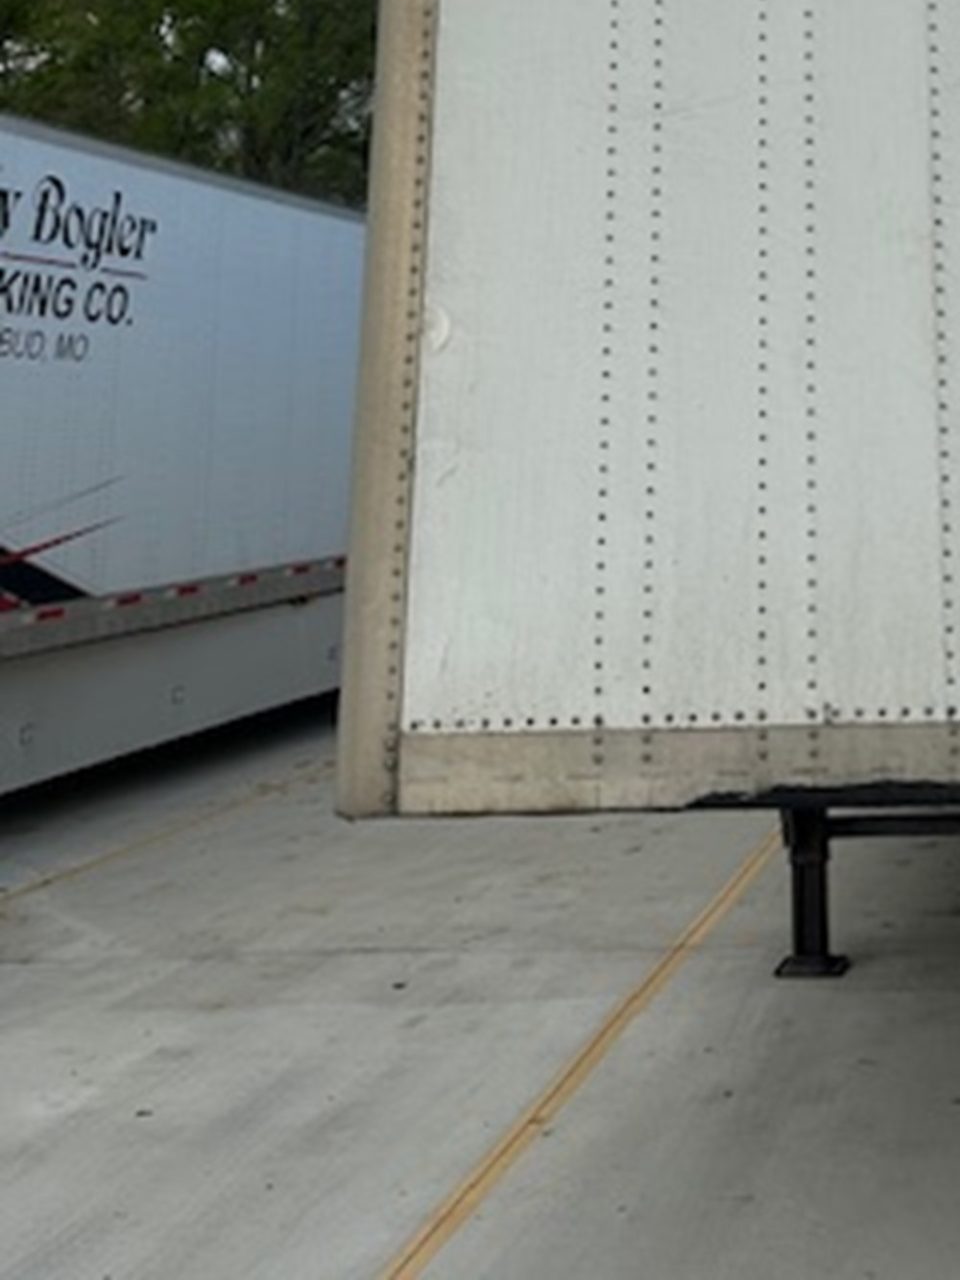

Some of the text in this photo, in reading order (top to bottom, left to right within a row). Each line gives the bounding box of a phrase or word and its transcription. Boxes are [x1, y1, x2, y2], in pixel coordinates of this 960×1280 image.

[33, 175, 157, 269] Bogler
[84, 282, 133, 325] CO.
[56, 332, 90, 362] MO
